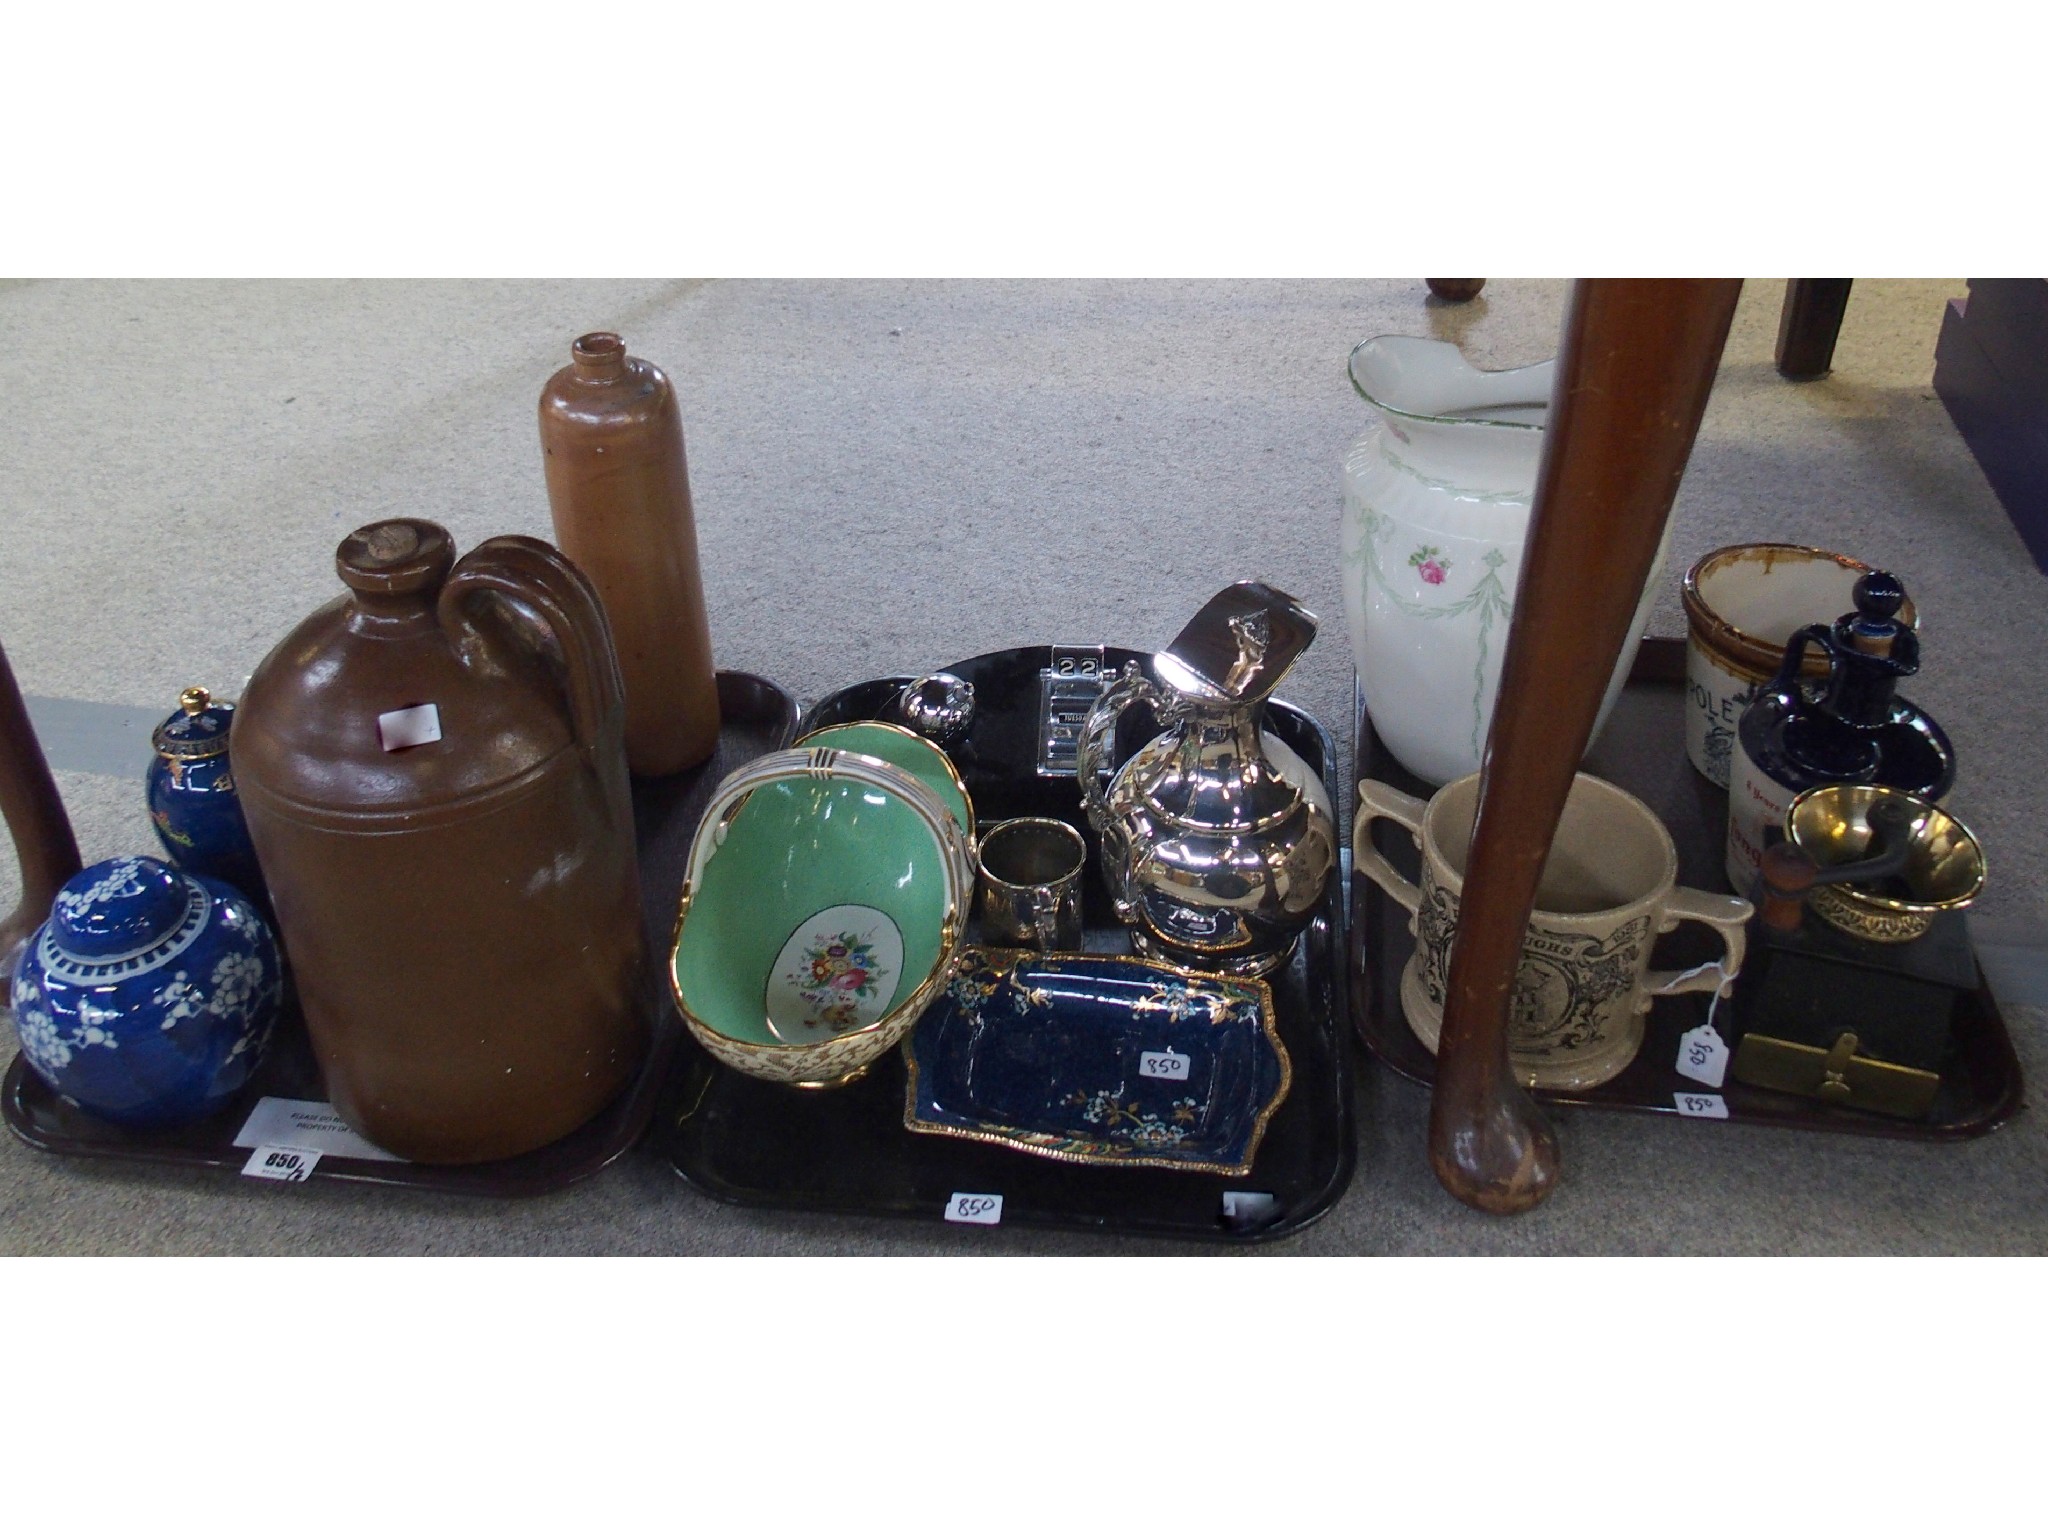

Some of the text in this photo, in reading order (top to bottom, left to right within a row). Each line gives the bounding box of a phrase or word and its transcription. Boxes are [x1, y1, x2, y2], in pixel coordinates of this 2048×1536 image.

[1147, 1057, 1181, 1074] 850
[1683, 1096, 1713, 1111] 850
[958, 1198, 995, 1216] 850
